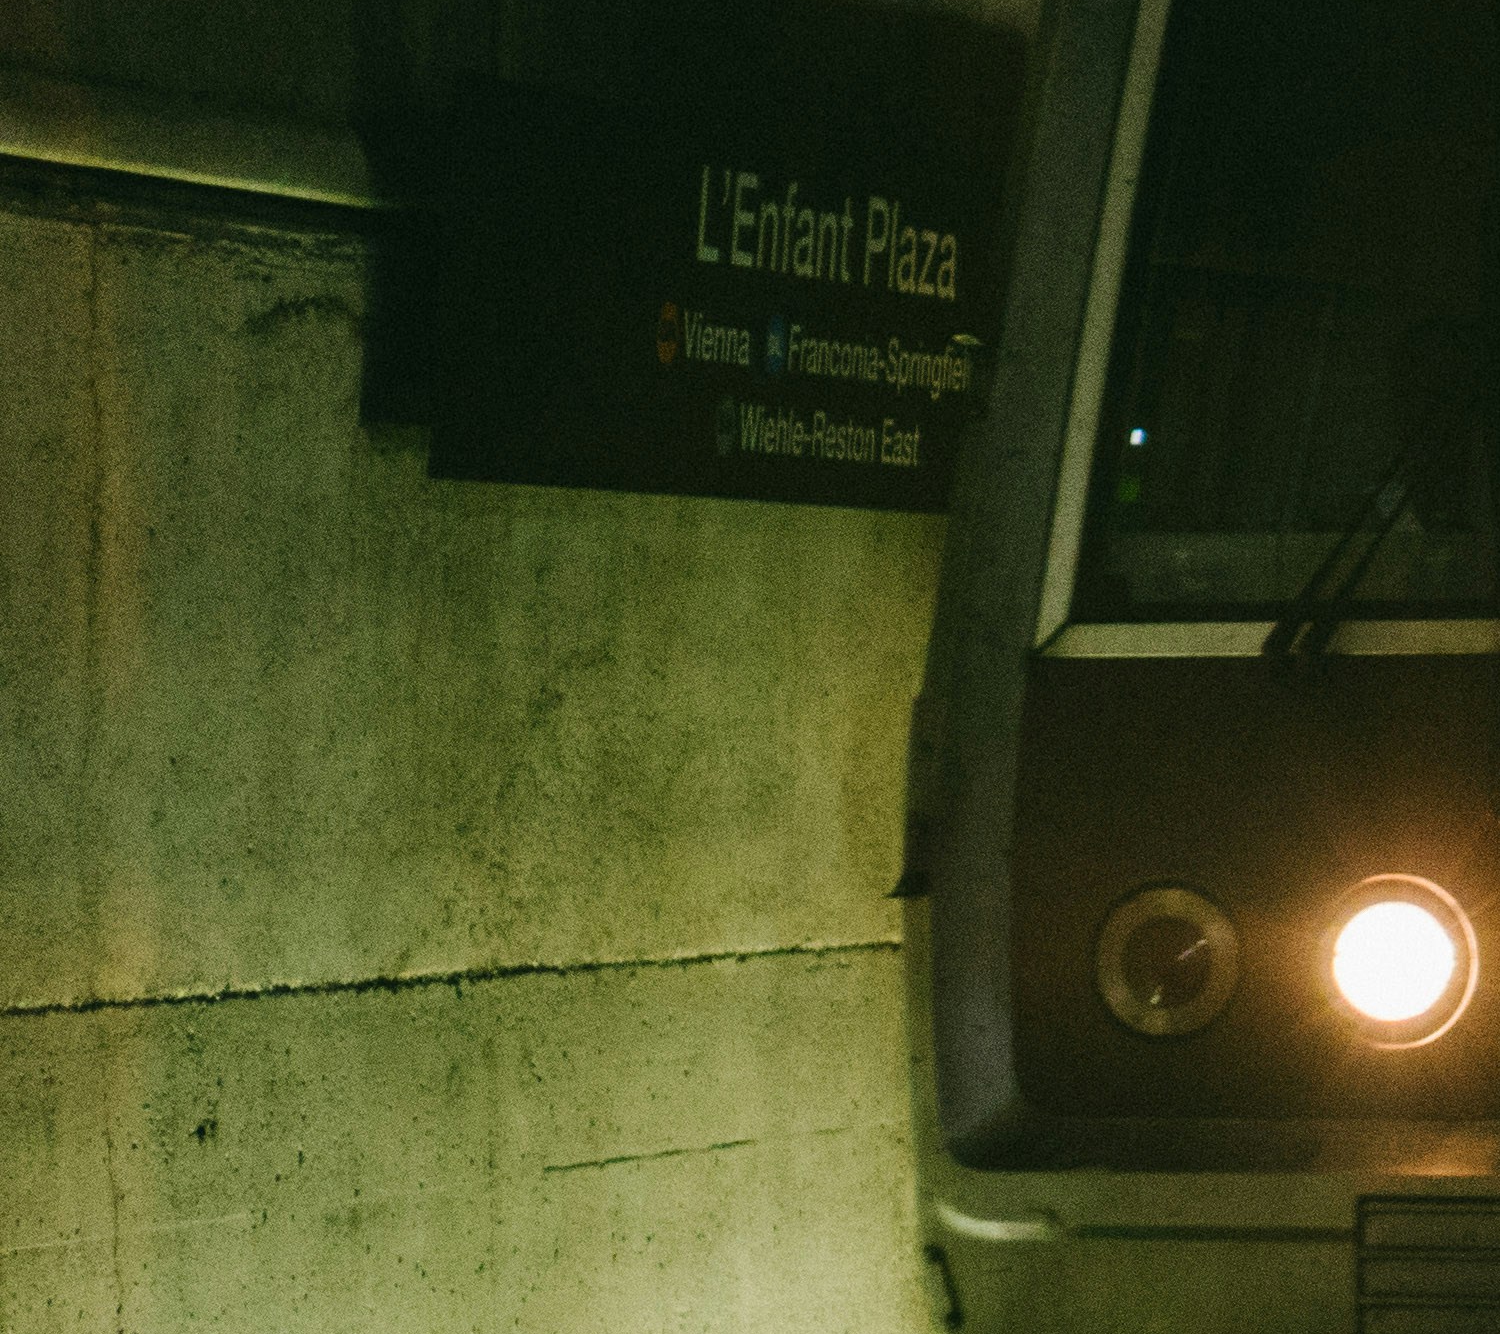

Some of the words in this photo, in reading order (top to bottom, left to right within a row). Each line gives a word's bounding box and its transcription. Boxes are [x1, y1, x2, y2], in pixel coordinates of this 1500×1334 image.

[696, 164, 855, 283] L'Enfant
[864, 196, 958, 302] Plaza
[683, 309, 751, 366] Vienna
[740, 400, 876, 463] Wiehle-Reston
[881, 417, 921, 468] East
